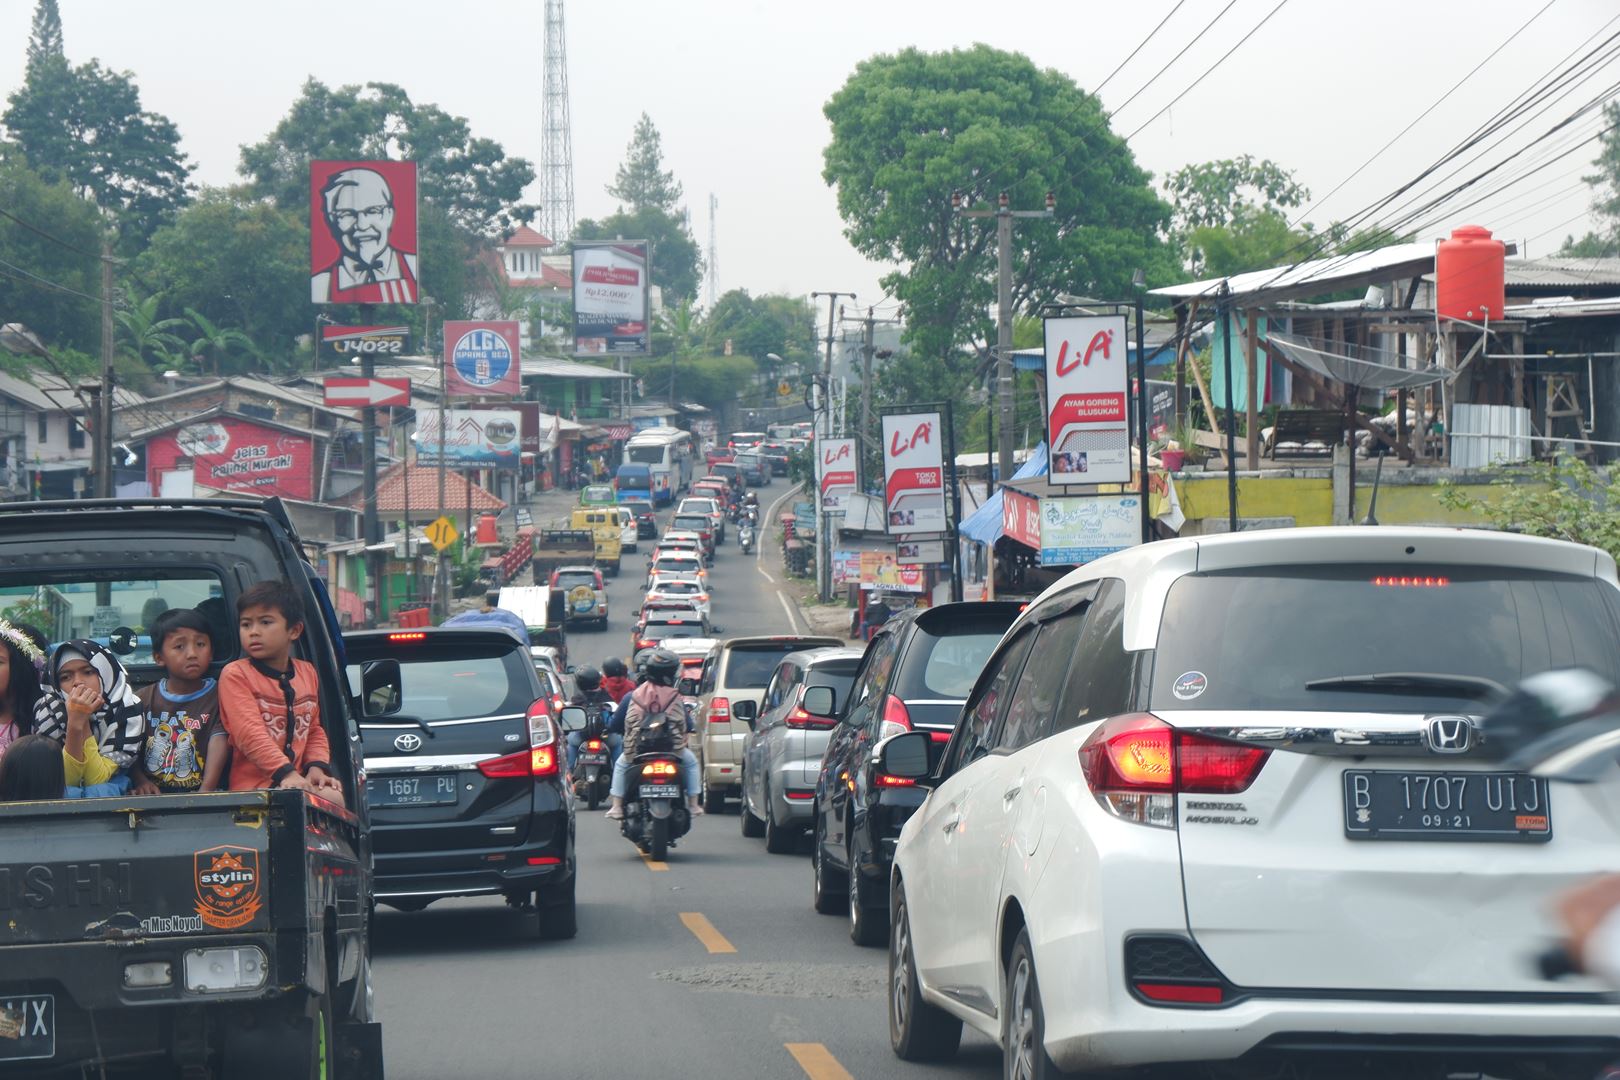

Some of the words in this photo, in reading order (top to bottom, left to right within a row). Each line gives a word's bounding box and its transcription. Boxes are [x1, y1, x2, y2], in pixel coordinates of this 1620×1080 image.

[1064, 399, 1085, 407] AYAM
[1086, 398, 1119, 406] GORENG
[1078, 408, 1119, 416] BLUSUKAN
[388, 778, 420, 796] 1667
[437, 777, 454, 793] PU
[1354, 775, 1371, 809] B
[1402, 776, 1467, 810] 1707
[1486, 777, 1540, 812] UIJ
[1186, 815, 1259, 826] MOBILIO
[201, 871, 253, 884] stylin
[150, 917, 171, 932] Mus
[171, 914, 203, 932] Noyod
